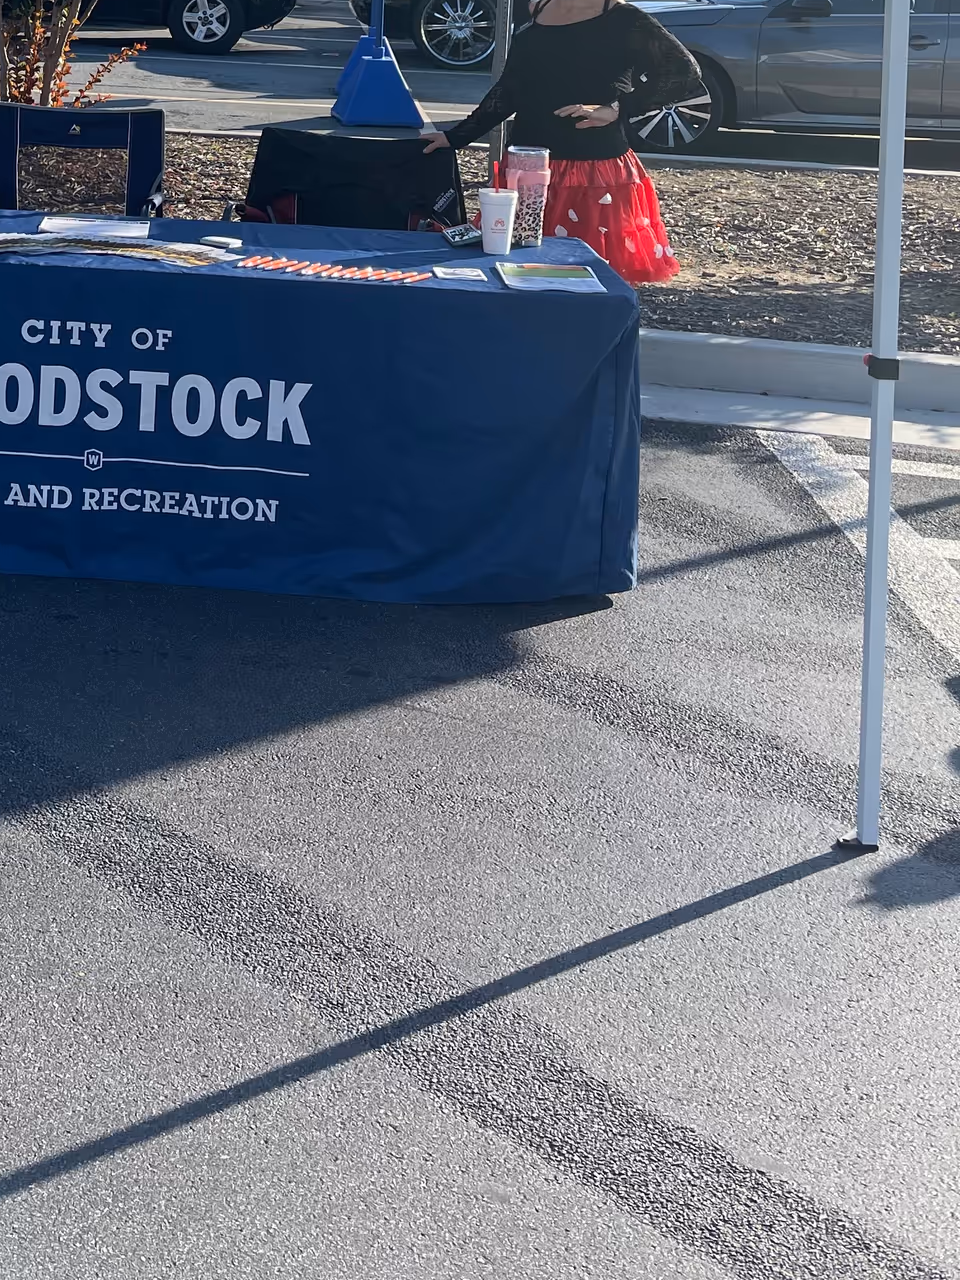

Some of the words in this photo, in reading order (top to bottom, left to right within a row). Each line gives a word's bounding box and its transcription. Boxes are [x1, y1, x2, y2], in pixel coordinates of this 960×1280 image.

[21, 319, 112, 348] CITY
[131, 327, 173, 351] OF
[88, 454, 99, 466] W
[4, 482, 73, 509] AND
[81, 487, 279, 522] RECREATION
